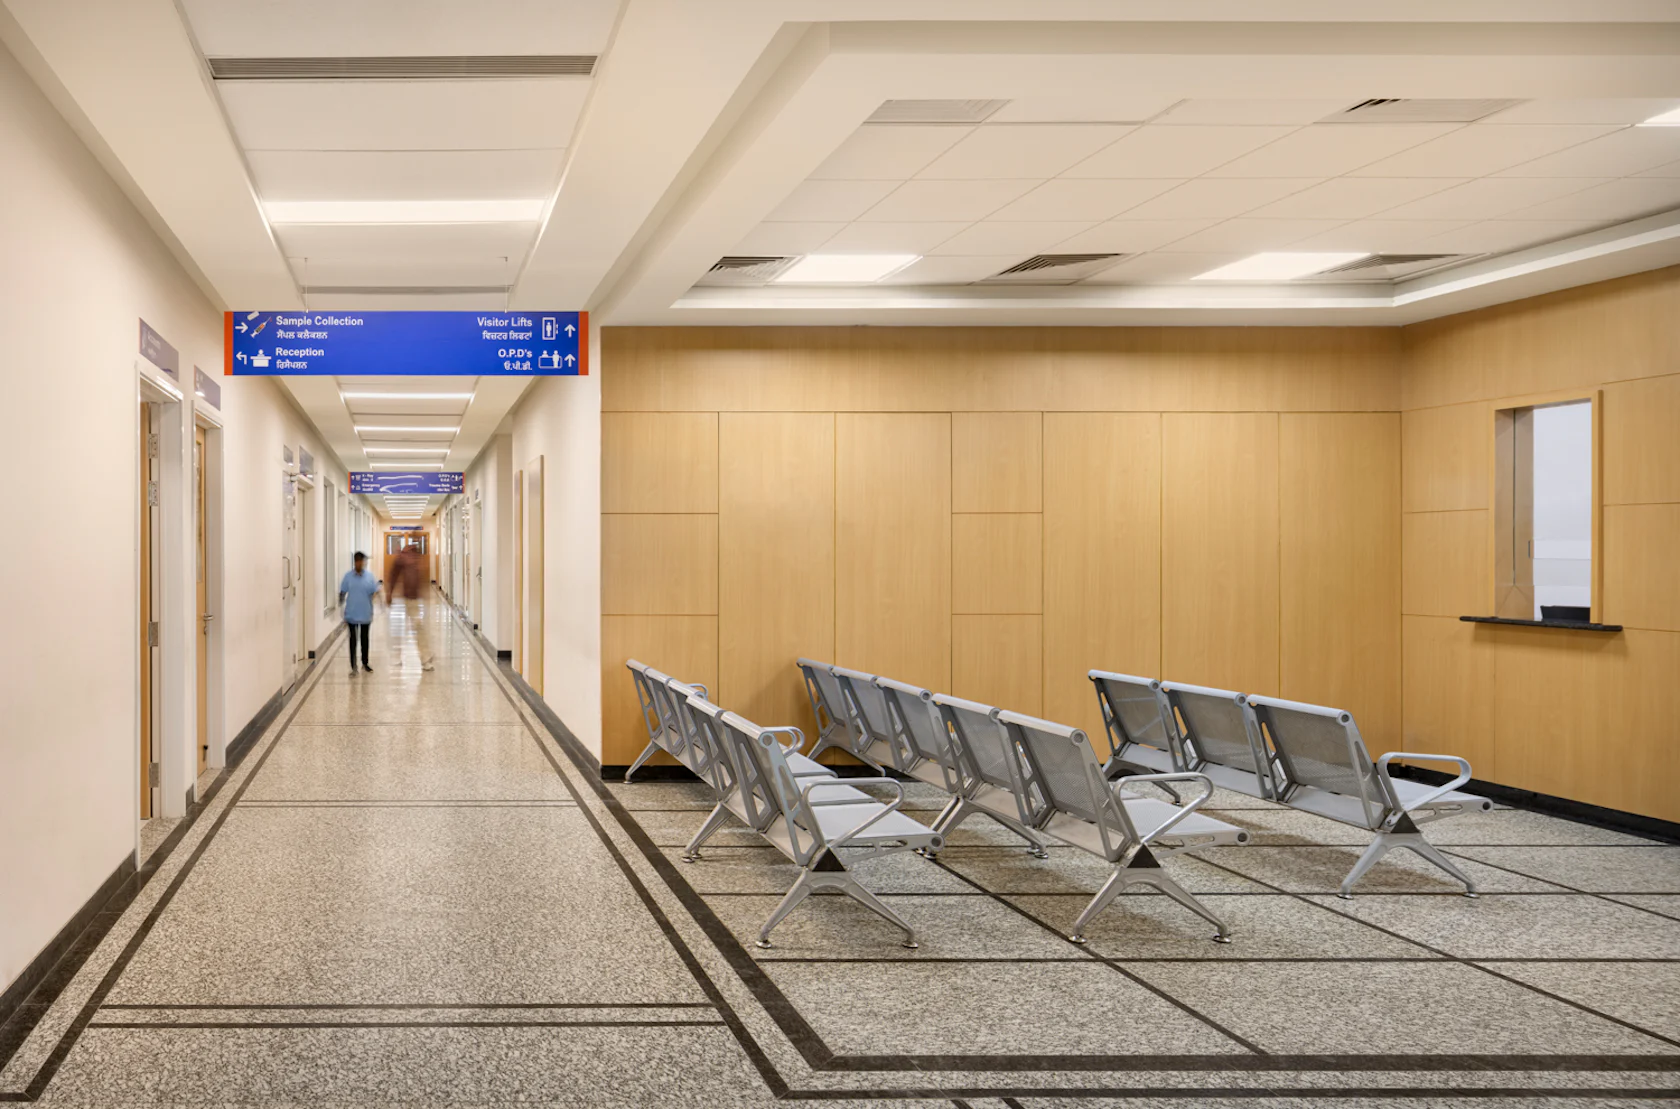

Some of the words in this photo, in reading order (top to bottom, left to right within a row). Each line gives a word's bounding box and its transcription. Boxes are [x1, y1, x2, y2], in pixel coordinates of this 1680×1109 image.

[276, 315, 312, 327] Sample
[315, 315, 364, 326] Collection
[477, 317, 509, 327] Visitor
[511, 317, 533, 327] Lifts
[275, 347, 325, 358] Reception
[498, 348, 533, 358] O.P.D's
